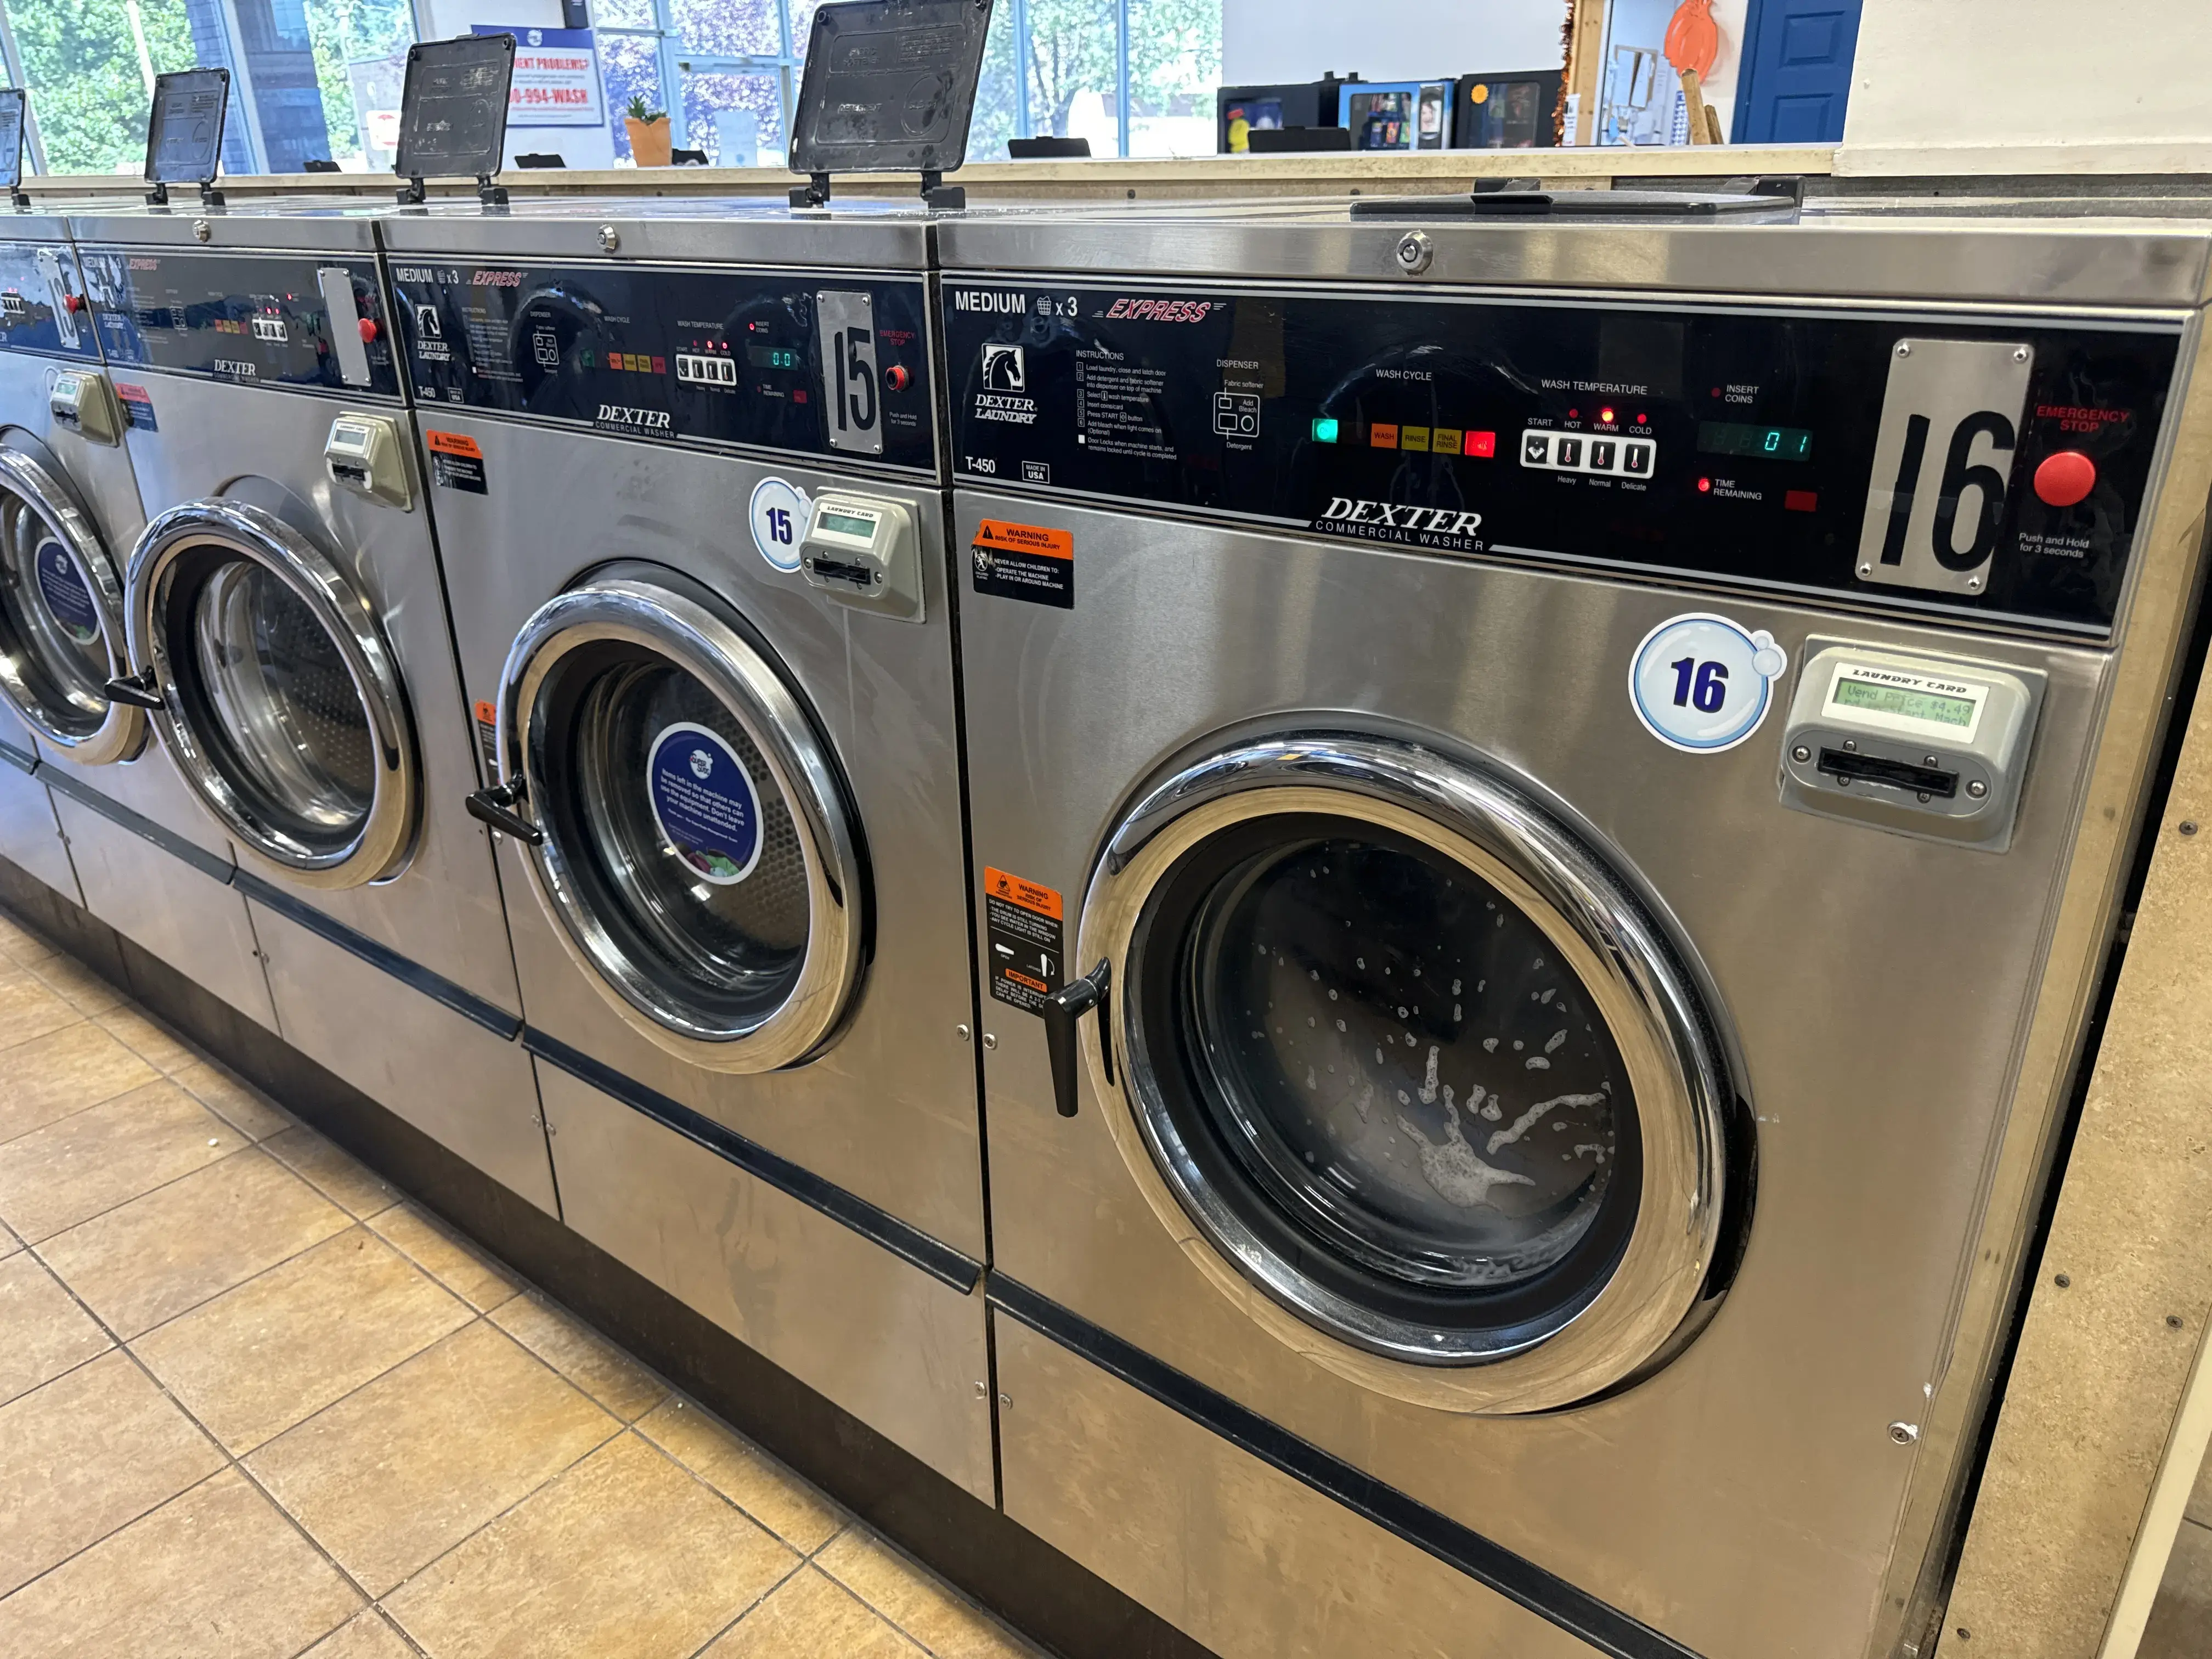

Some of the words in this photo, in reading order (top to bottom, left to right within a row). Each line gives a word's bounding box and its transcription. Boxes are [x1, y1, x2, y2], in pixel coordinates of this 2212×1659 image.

[396, 268, 433, 283] MEDIUM
[447, 275, 452, 283] x
[452, 270, 459, 284] 3
[472, 270, 522, 287] EXPRESS
[955, 291, 1026, 314] MEDIUM
[1056, 302, 1064, 316] x
[1068, 296, 1078, 317] 3
[1106, 298, 1211, 323] EXPRESS
[691, 321, 724, 330] TEMPERATURE
[880, 330, 916, 339] EMERGENCY
[417, 340, 448, 352] DEXTER
[890, 337, 905, 346] STOP
[1076, 350, 1124, 360] INSTRUCTIONS
[214, 359, 256, 376] DEXTER
[1216, 359, 1259, 370] DISPENSER
[834, 327, 877, 431] 15
[1376, 369, 1401, 380] WASH
[1403, 370, 1432, 381] CYCLE
[1541, 379, 1570, 390] WASH
[1573, 381, 1648, 395] TEMPERATURE
[1726, 385, 1759, 394] INSERT
[975, 394, 1035, 411] DEXTER
[1121, 394, 1149, 402] temperature
[1725, 394, 1753, 404] COINS
[1239, 405, 1257, 413] Bleach
[2036, 405, 2130, 423] EMERGENCY
[597, 404, 670, 428] DEXTER
[975, 408, 1037, 424] LAUNDRY
[1527, 417, 1553, 427] START
[595, 421, 642, 434] COMMERCIAL
[644, 428, 675, 438] WASHER
[1564, 421, 1582, 429] HOT
[1593, 423, 1619, 432] WARM
[1629, 426, 1652, 435] COLD
[2060, 420, 2100, 433] STOP
[1374, 432, 1395, 440] WASH
[1405, 435, 1426, 443] RINSE
[1438, 434, 1457, 442] FINAL
[1227, 442, 1252, 450] Detergent
[1436, 441, 1458, 449] RINSE
[966, 456, 996, 473] T-450
[1028, 471, 1044, 480] USA
[1558, 475, 1577, 486] Heavy
[1589, 478, 1611, 488] Normal
[1621, 482, 1646, 491] Delicate
[1714, 478, 1736, 488] TIME
[1713, 488, 1763, 500] REMAINING
[1880, 410, 2015, 572] 16
[827, 506, 856, 515] LAUNDRY
[1321, 496, 1482, 537] DEXTER
[766, 507, 793, 545] 15
[1006, 528, 1049, 541] WARNING
[1316, 520, 1412, 542] COMMERCIAL
[1420, 533, 1483, 551] WASHER
[2018, 532, 2044, 543] Push
[2045, 535, 2064, 546] and
[2066, 537, 2090, 549] Hold
[1017, 538, 1040, 547] SERIOUS
[2019, 543, 2033, 552] for
[2034, 544, 2042, 553] 3
[2043, 546, 2084, 558] seconds
[994, 557, 1009, 566] NEVER
[1010, 560, 1026, 568] ALLOW
[1026, 563, 1051, 572] CHILDREN
[1028, 572, 1049, 580] MACHINE
[1022, 578, 1042, 586] AROUND
[1042, 581, 1064, 590] MACHINE
[1670, 656, 1729, 714] 16
[1853, 669, 1922, 686] LAUNDRY
[1926, 681, 1967, 693] CARD
[1930, 700, 1971, 715] $4.49
[676, 775, 686, 785] left
[686, 780, 692, 788] in
[692, 783, 702, 792] the
[703, 788, 728, 803] machine
[729, 799, 742, 810] may
[668, 781, 691, 795] removed
[699, 794, 712, 805] that
[712, 800, 731, 813] others
[732, 809, 744, 817] can
[670, 788, 679, 798] the
[711, 807, 727, 820] Don't
[728, 814, 745, 826] leave
[679, 802, 702, 817] machine
[1018, 883, 1049, 899] WARNING
[1020, 910, 1032, 918] OPEN
[1009, 970, 1043, 990] IMPORTANT
